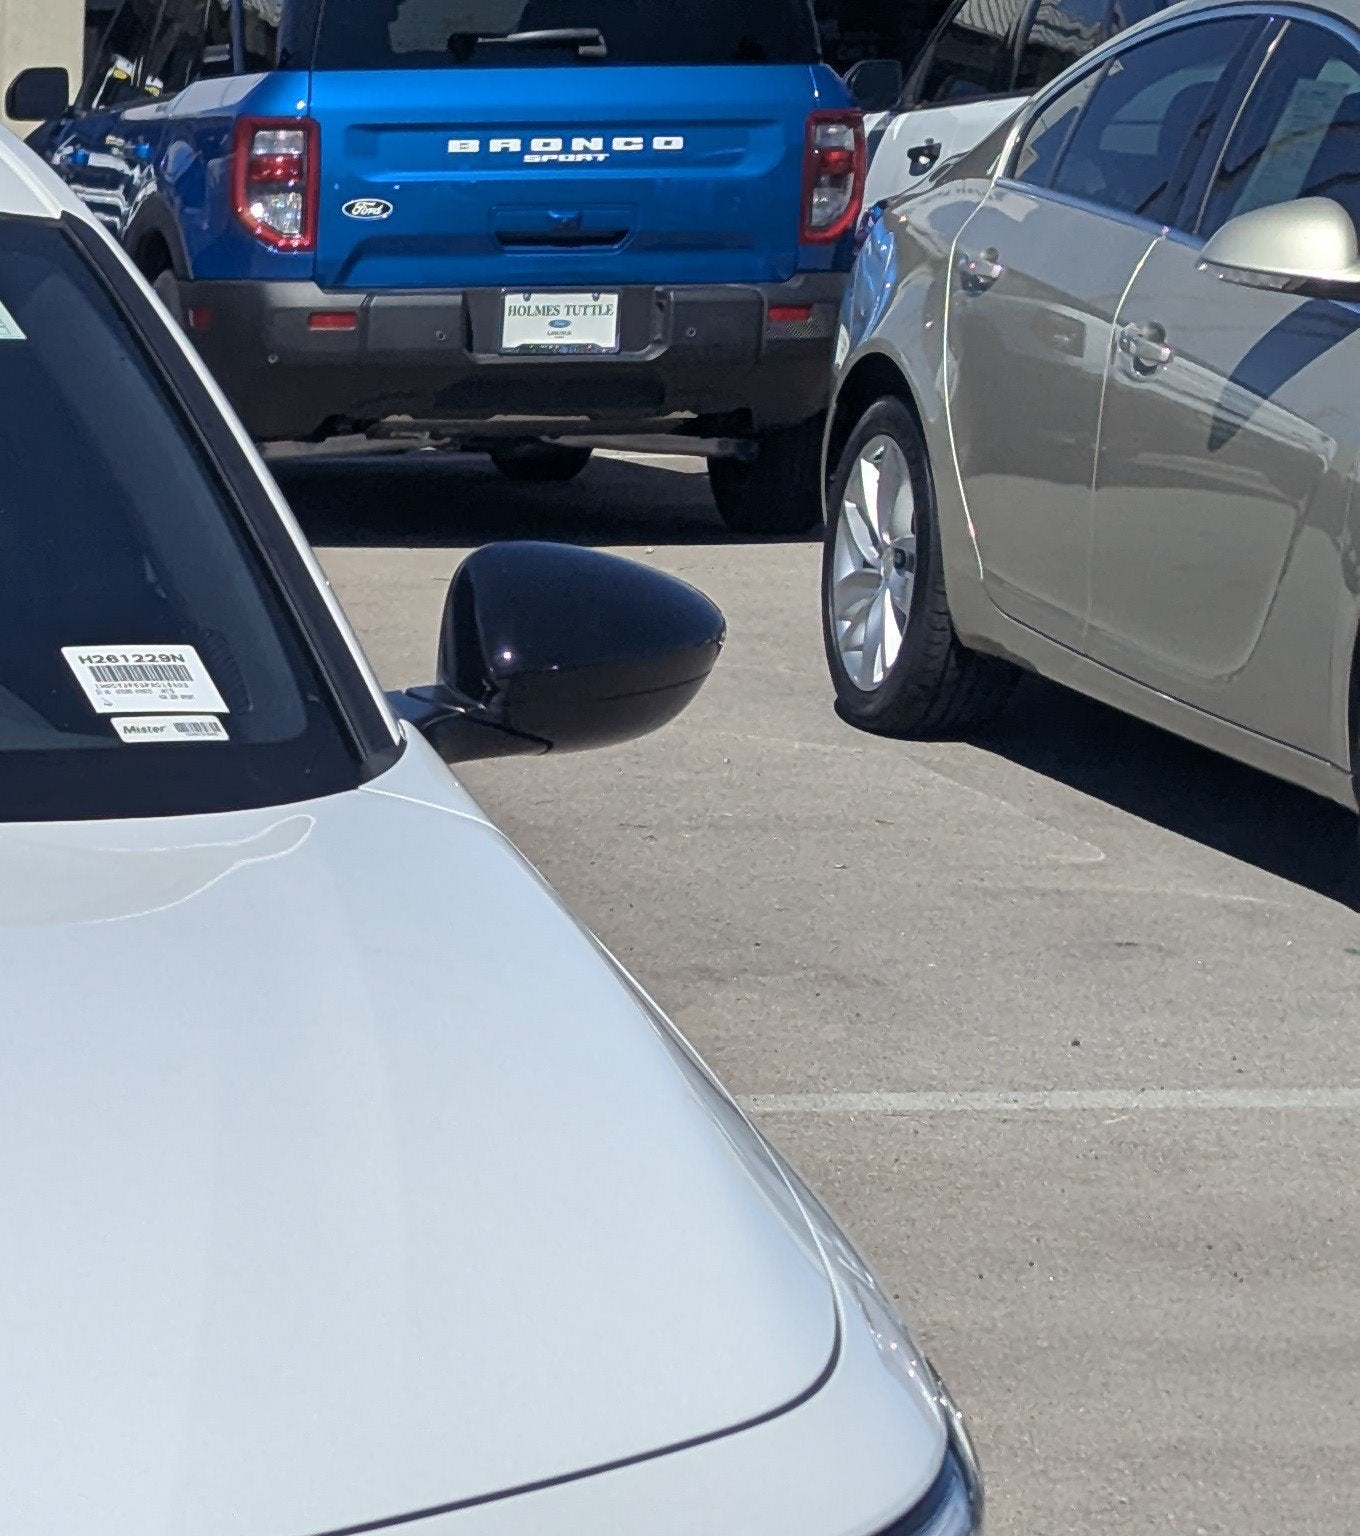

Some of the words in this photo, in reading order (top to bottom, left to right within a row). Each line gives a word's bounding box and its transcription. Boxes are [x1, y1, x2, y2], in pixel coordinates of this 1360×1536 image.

[448, 136, 684, 152] BRONCO
[523, 153, 610, 162] SPORT
[507, 304, 560, 316] HOLMES
[564, 304, 615, 316] TUTTLE
[122, 724, 167, 735] Mister
